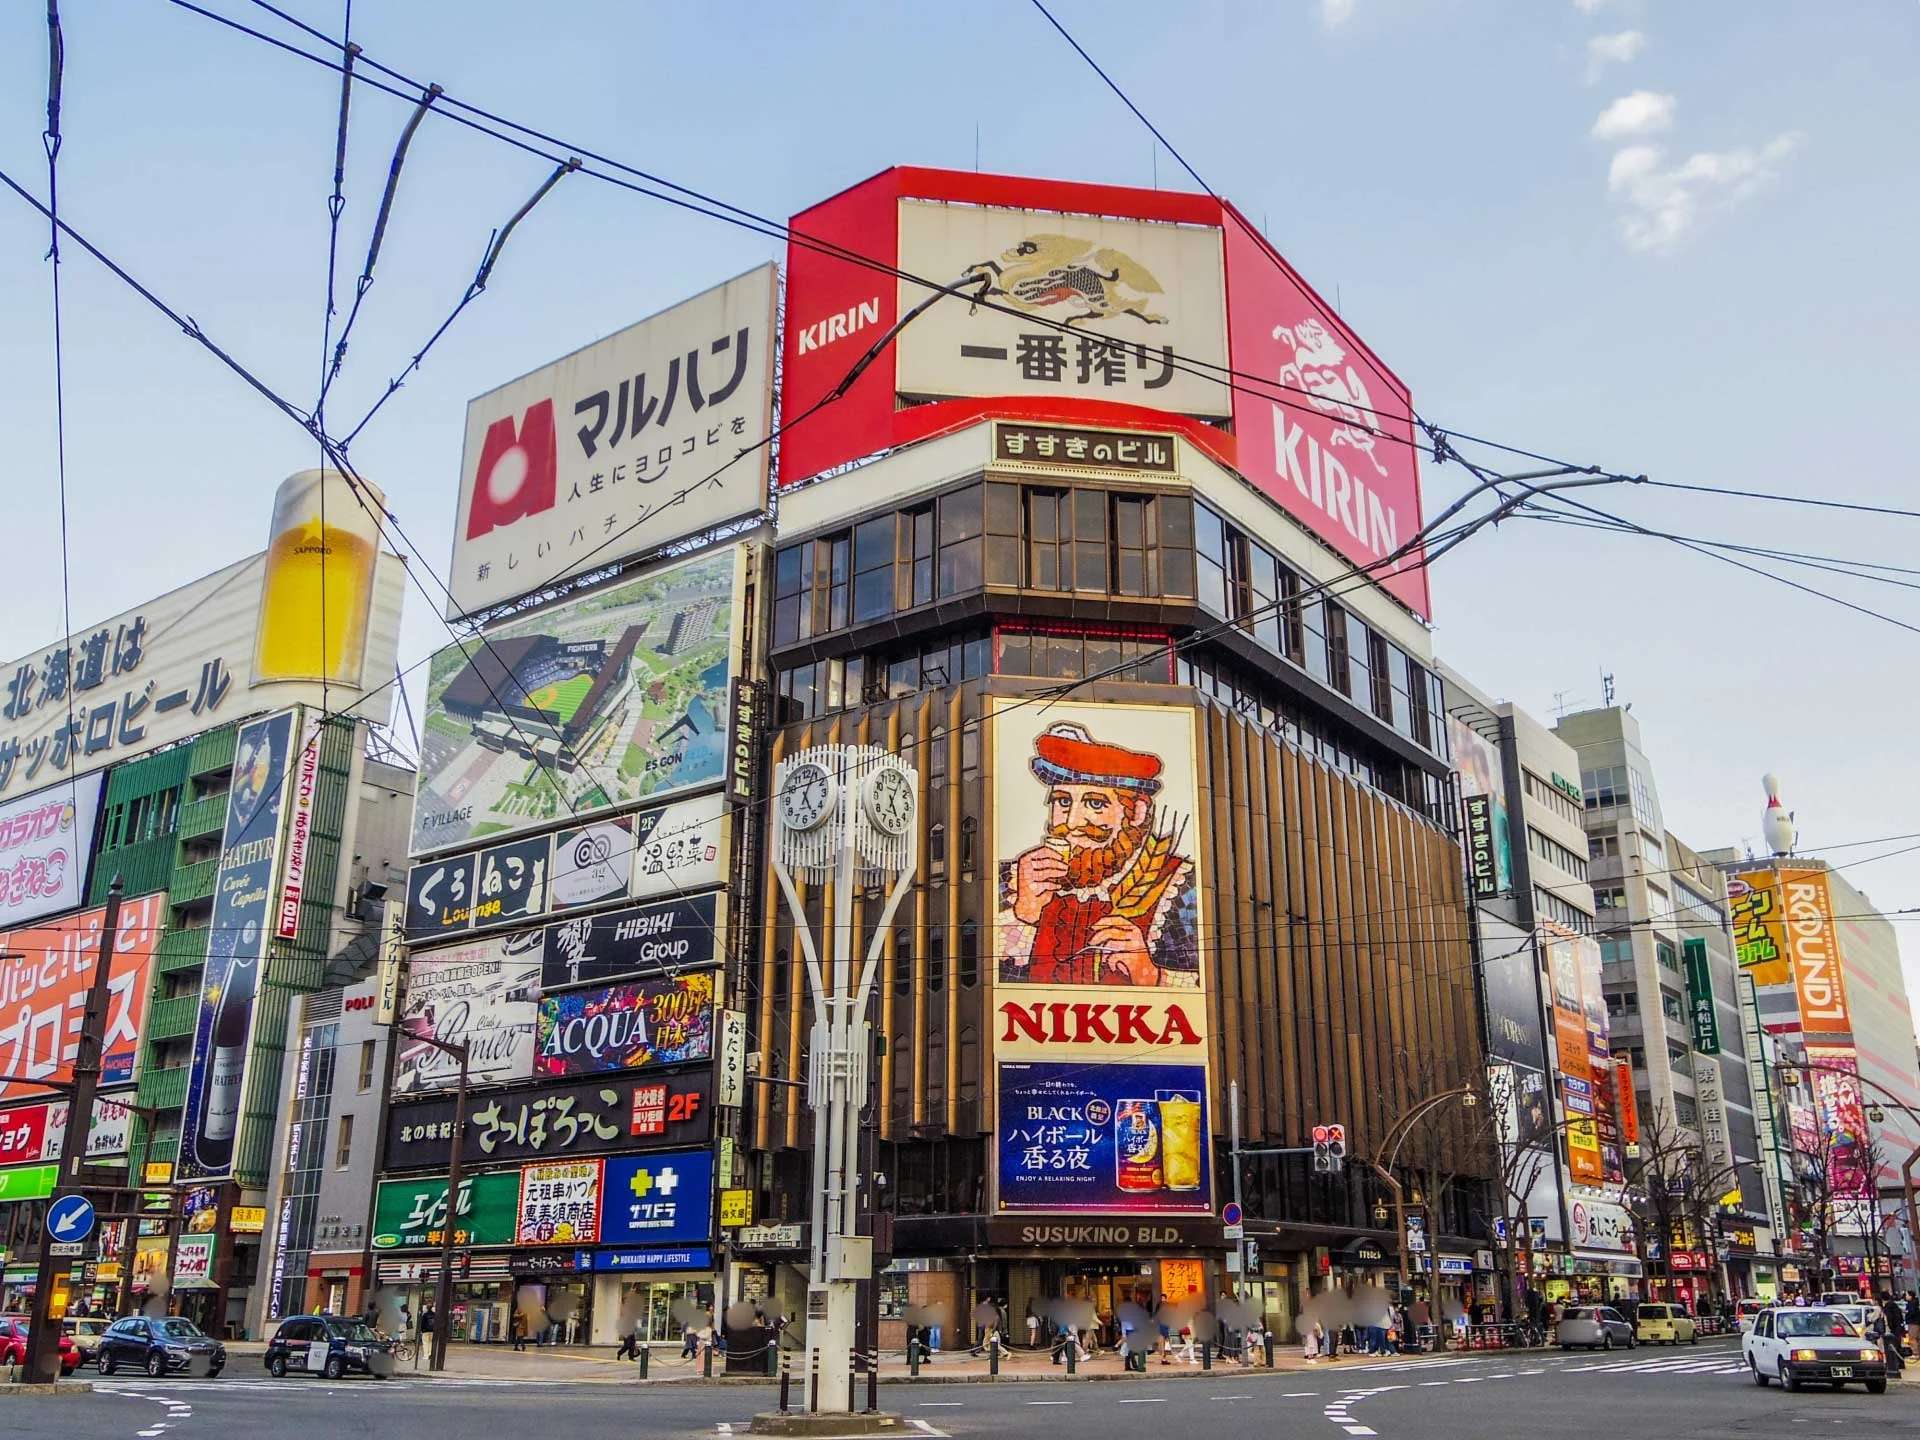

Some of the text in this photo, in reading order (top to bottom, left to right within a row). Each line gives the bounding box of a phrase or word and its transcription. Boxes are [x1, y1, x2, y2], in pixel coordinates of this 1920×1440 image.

[799, 297, 879, 355] KIRIN
[961, 334, 1174, 389] 一番搾り
[575, 327, 748, 459] マルハン
[568, 417, 746, 502] 人生にヨロコビを
[1004, 433, 1167, 466] すすきのビル
[1272, 403, 1400, 575] KIRIN
[476, 477, 724, 582] 新しいパチンコへ
[4, 616, 146, 720] 北海道は
[0, 658, 232, 792] サッポロビール
[801, 770, 813, 780] 12
[887, 774, 897, 784] 12
[820, 788, 827, 798] 3
[875, 781, 884, 792] 10
[785, 796, 791, 806] 9
[787, 807, 794, 817] 8
[875, 803, 882, 813] 8
[904, 801, 911, 812] 3
[432, 805, 473, 824] VILLAGE
[641, 816, 656, 832] 2F
[794, 813, 801, 824] 7
[802, 815, 808, 825] 6
[810, 809, 817, 820] 5
[881, 813, 887, 823] 7
[888, 817, 895, 829] 6
[896, 817, 902, 828] 5
[0, 803, 64, 851] カラオケ
[1469, 800, 1495, 893] すすきのビル
[419, 855, 525, 916] くろねこ
[441, 899, 502, 926] Lounge
[614, 912, 675, 942] HIBIKI
[0, 899, 150, 1010] パッと!ピと!
[639, 939, 689, 962] Group
[1788, 883, 1844, 1019] ROUND1
[542, 1008, 648, 1058] ACQUA
[999, 1001, 1202, 1045] NIKKA
[668, 1093, 700, 1121] 2F
[1027, 1106, 1084, 1121] BLACK
[472, 1089, 619, 1153] さっぽろっこ
[1007, 1126, 1103, 1145] ハイボール
[1021, 1146, 1091, 1170] 香る夜
[526, 1180, 587, 1202] 元祖串かつ
[523, 1202, 594, 1221] 恵美須商店
[540, 1229, 551, 1241] 1F
[1022, 1226, 1184, 1244] SUSUKINO BLD.
[620, 1254, 691, 1265] HOKKAIDO HAPPY LIFESTYLE
